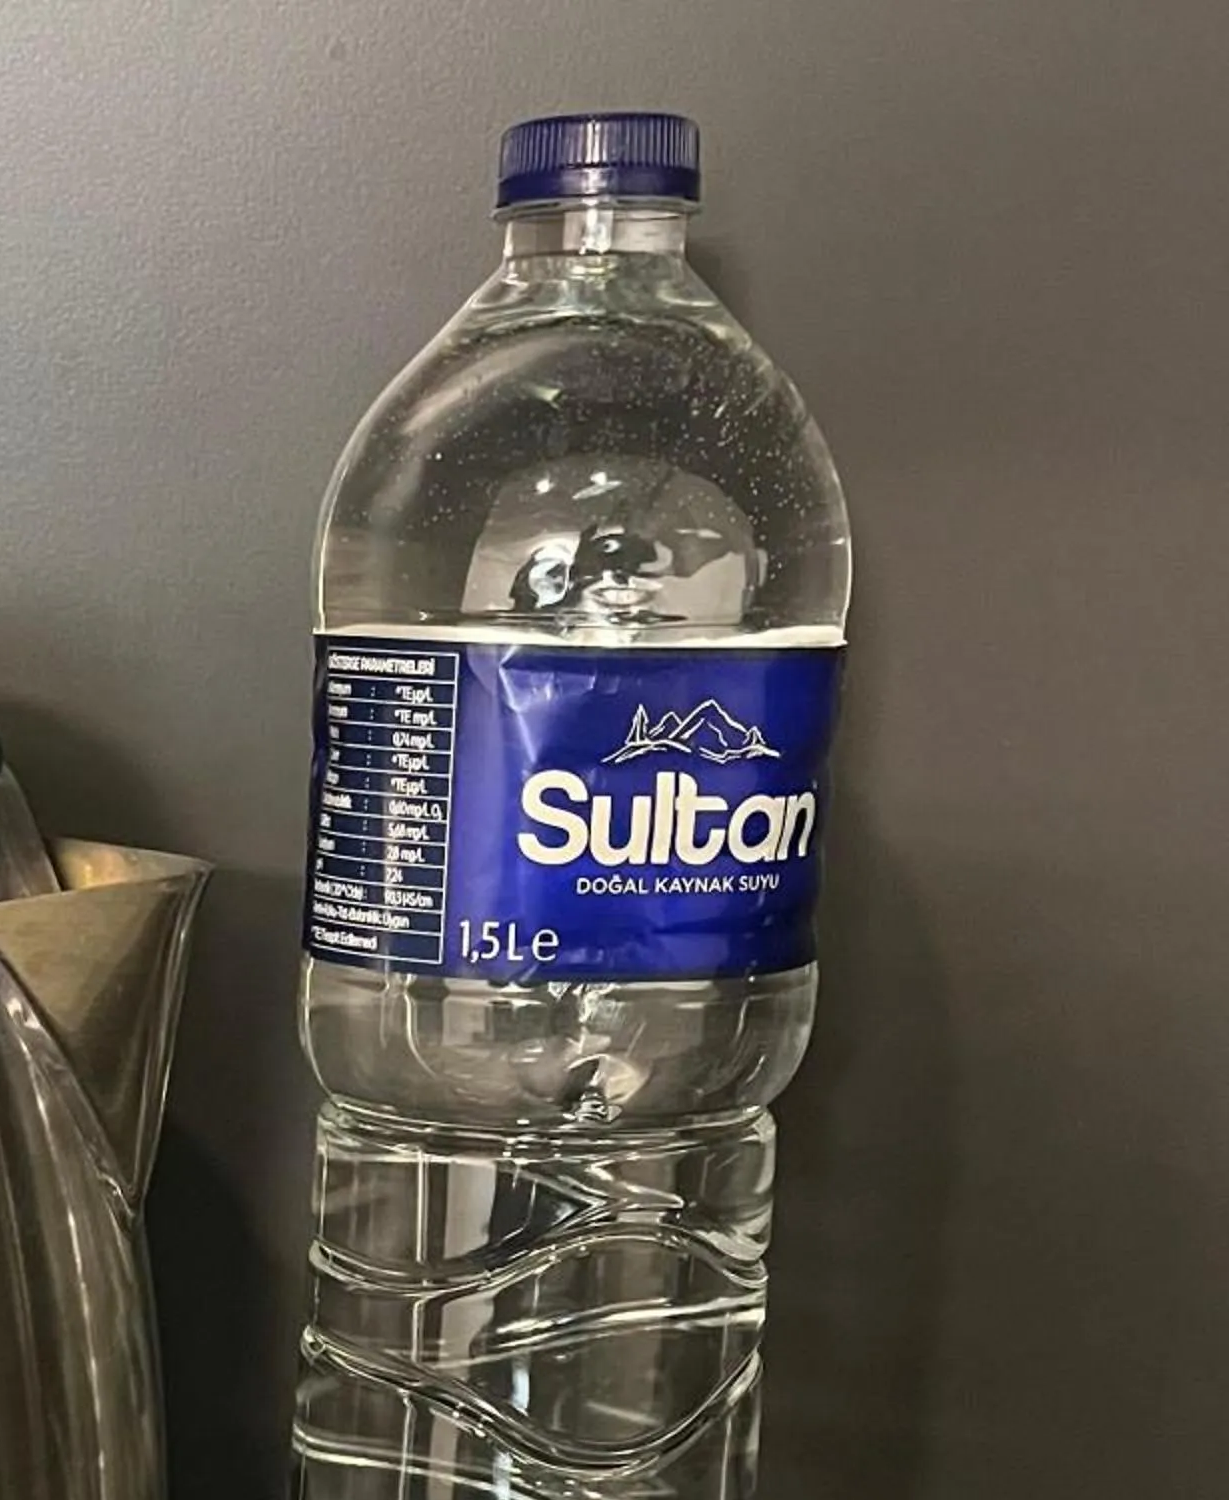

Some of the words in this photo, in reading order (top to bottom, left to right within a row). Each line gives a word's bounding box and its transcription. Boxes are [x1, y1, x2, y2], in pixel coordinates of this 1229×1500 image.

[517, 769, 816, 866] Sultan
[575, 875, 648, 894] DOĞAL
[654, 876, 734, 893] KAYNAK
[738, 874, 780, 891] SUYU
